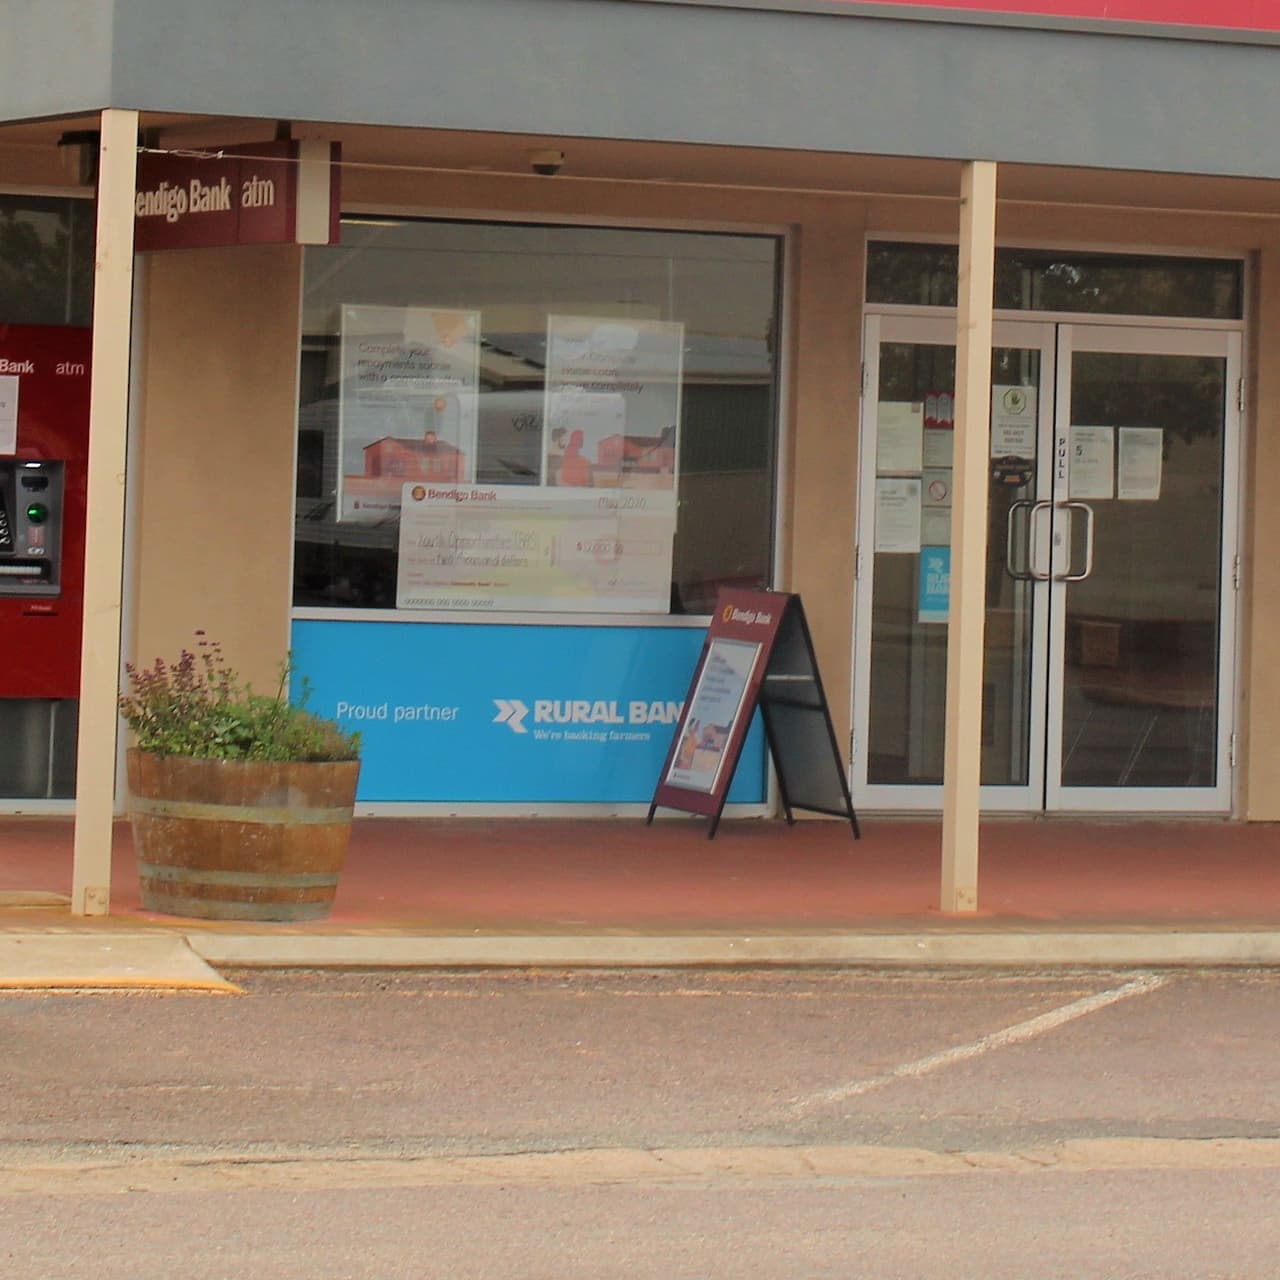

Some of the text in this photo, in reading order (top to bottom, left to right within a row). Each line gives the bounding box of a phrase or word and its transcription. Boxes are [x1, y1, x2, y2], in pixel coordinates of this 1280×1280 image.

[135, 174, 276, 223] endigo Bank atm
[55, 361, 85, 377] atm
[1058, 438, 1066, 479] PULL
[427, 488, 497, 503] Bendigo Bank
[336, 701, 459, 724] Proud partner
[534, 699, 686, 724] RURAL BAN
[563, 729, 607, 743] backing
[608, 729, 651, 742] farmers
